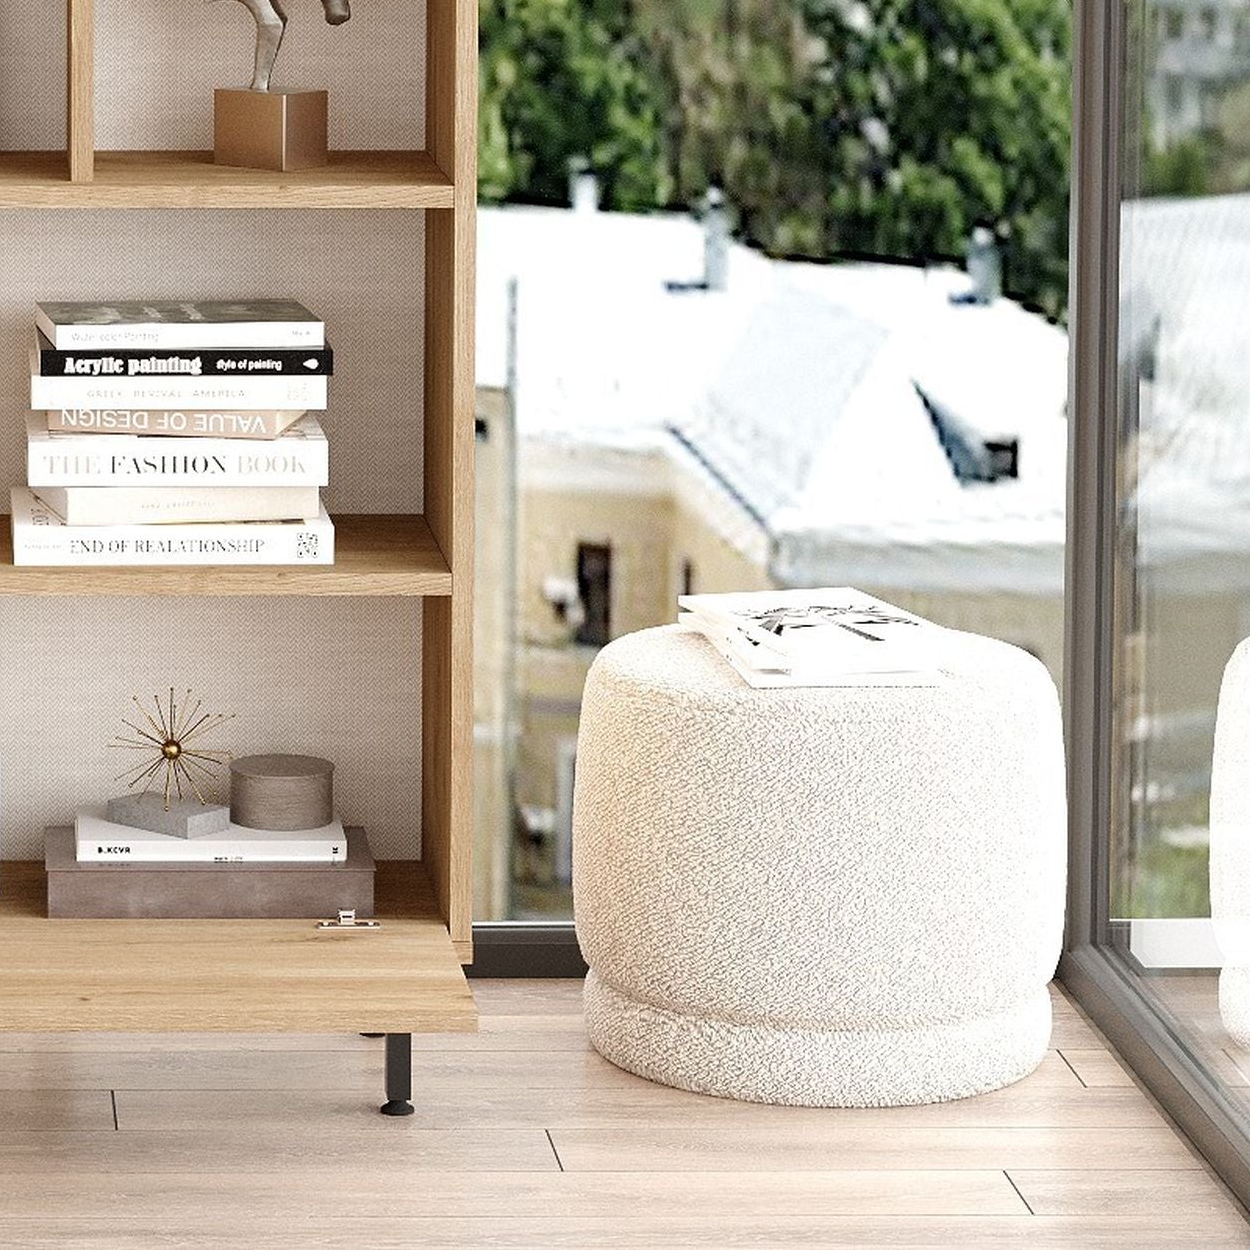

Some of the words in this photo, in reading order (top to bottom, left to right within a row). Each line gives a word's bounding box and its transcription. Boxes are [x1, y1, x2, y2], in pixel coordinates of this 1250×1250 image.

[64, 356, 124, 376] Acrylic
[127, 355, 202, 376] painting
[216, 358, 236, 371] style
[237, 358, 248, 370] of
[248, 358, 282, 371] painting
[61, 409, 149, 429] DESIGN
[156, 412, 187, 431] OF
[194, 413, 267, 434] VALUE
[43, 455, 101, 475] THE
[111, 455, 227, 475] FASHION
[238, 455, 307, 474] BOOK
[70, 538, 105, 554] END
[108, 538, 128, 554] OF
